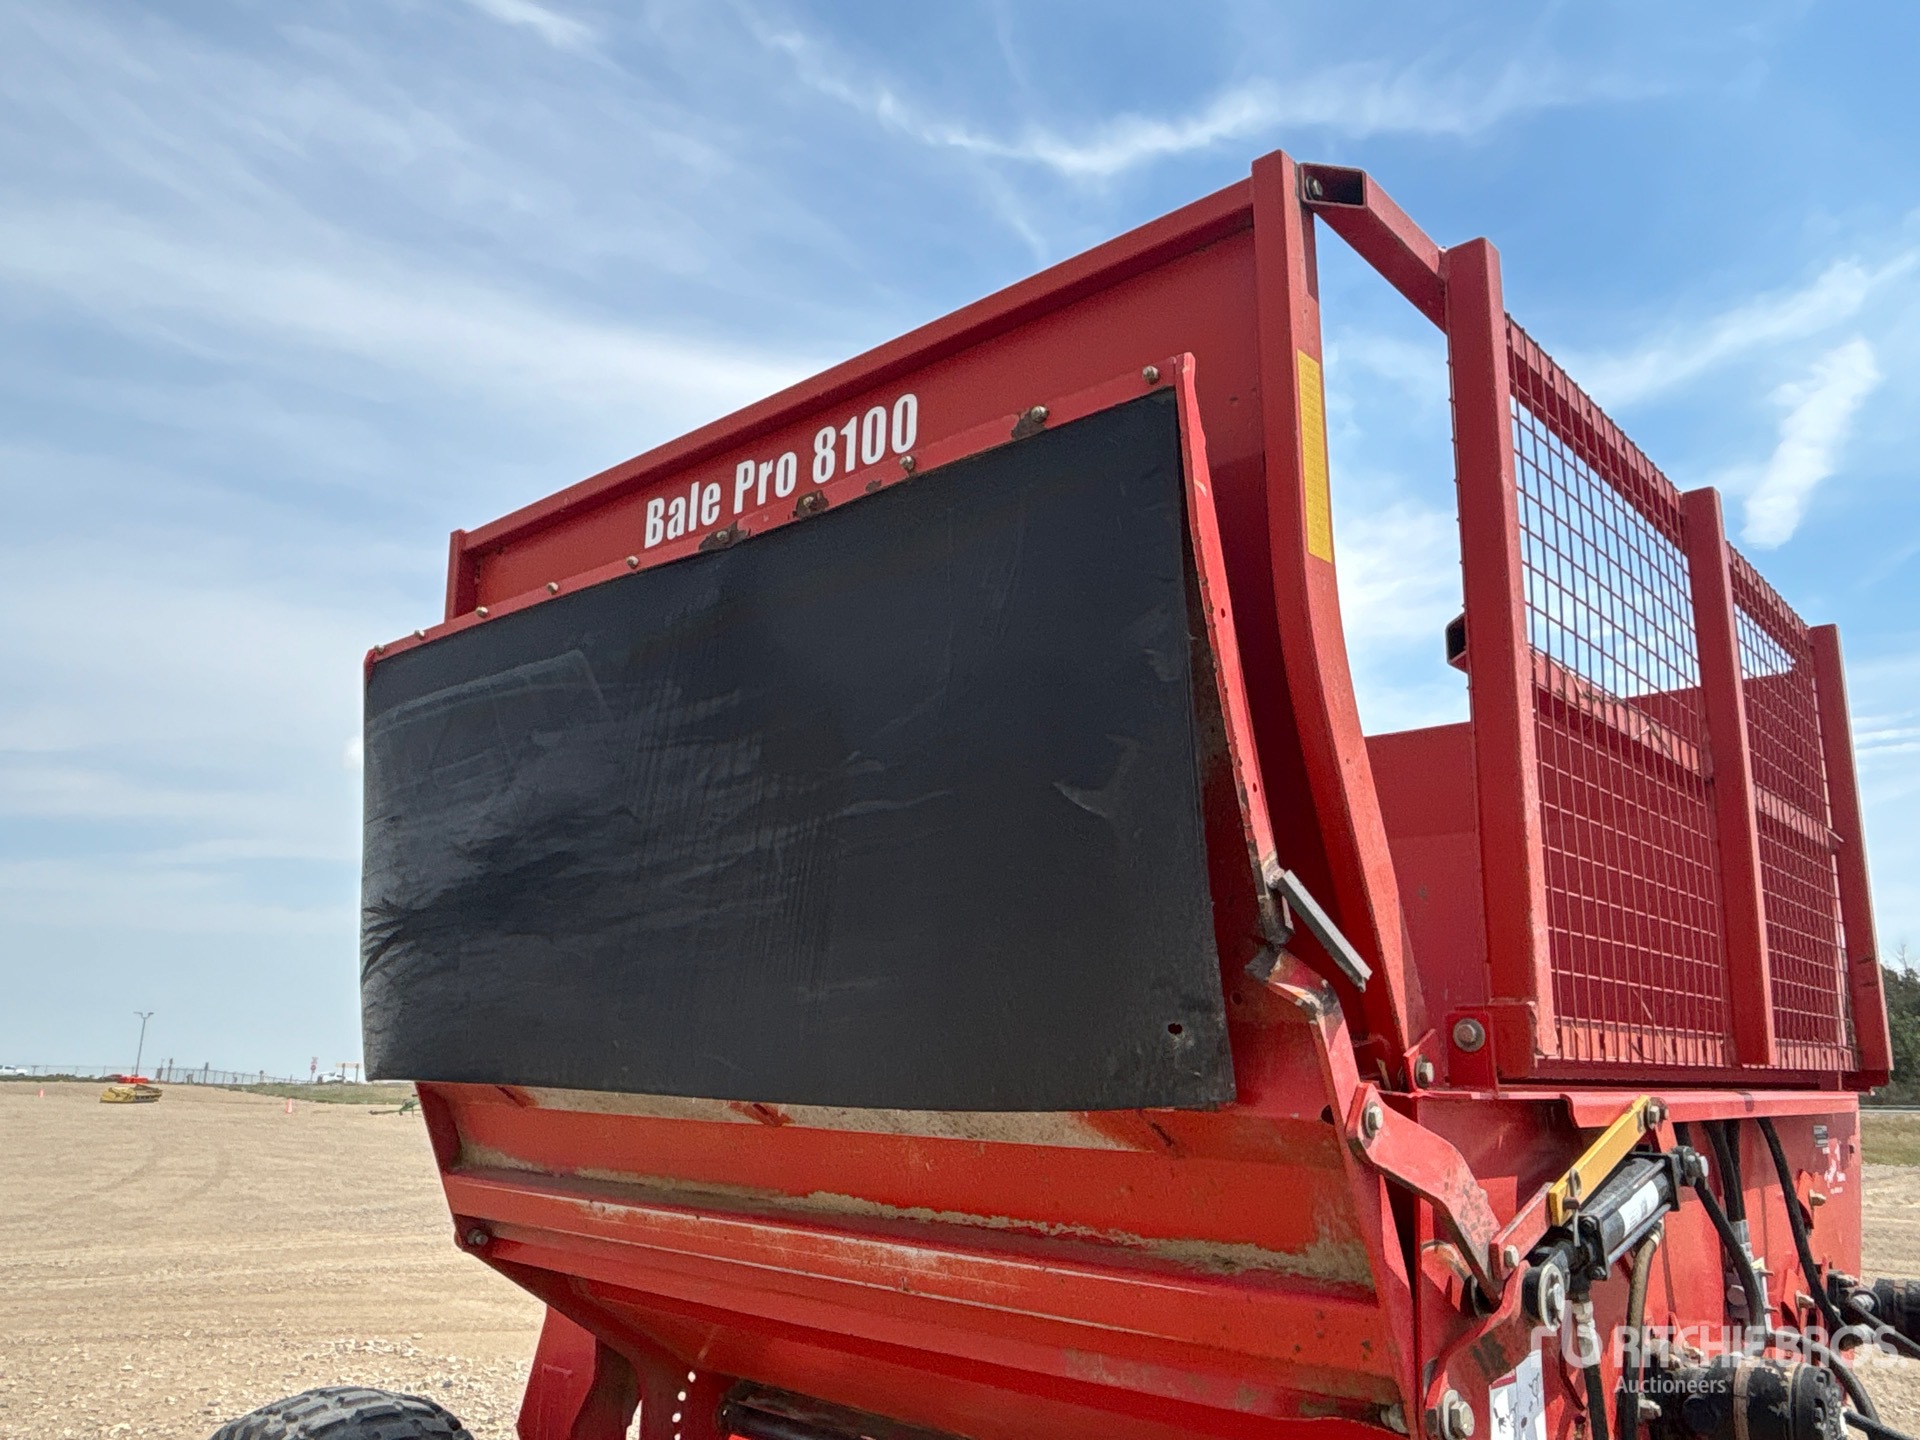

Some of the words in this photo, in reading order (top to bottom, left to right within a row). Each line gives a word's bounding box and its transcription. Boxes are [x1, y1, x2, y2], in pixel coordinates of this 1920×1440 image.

[645, 481, 721, 548] Bale
[733, 451, 797, 514] Pro
[812, 393, 918, 484] 8100
